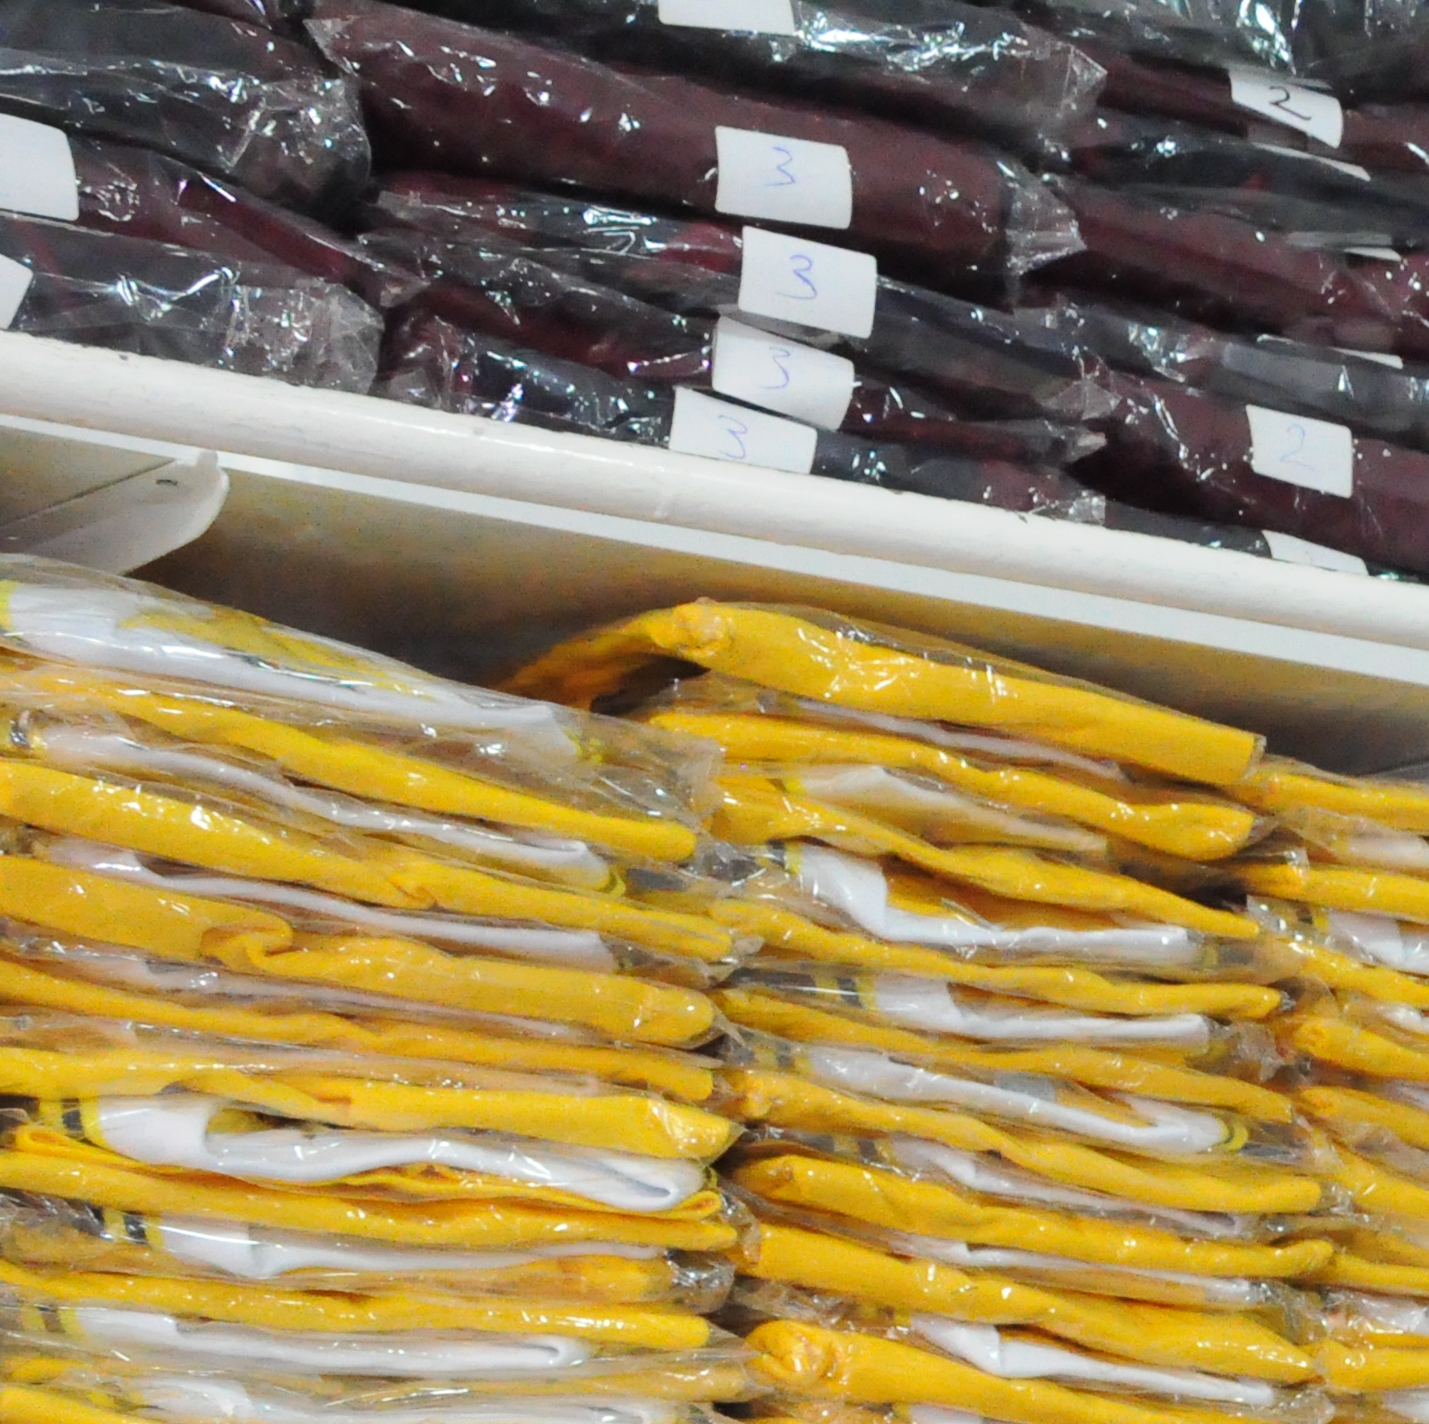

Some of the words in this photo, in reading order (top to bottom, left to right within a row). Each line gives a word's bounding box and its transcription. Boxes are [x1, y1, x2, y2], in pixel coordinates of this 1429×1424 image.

[1268, 86, 1312, 121] 2
[763, 146, 796, 186] 3
[776, 254, 818, 300] 3
[759, 346, 790, 389] 3
[718, 414, 749, 459] 3
[1279, 423, 1316, 471] 2
